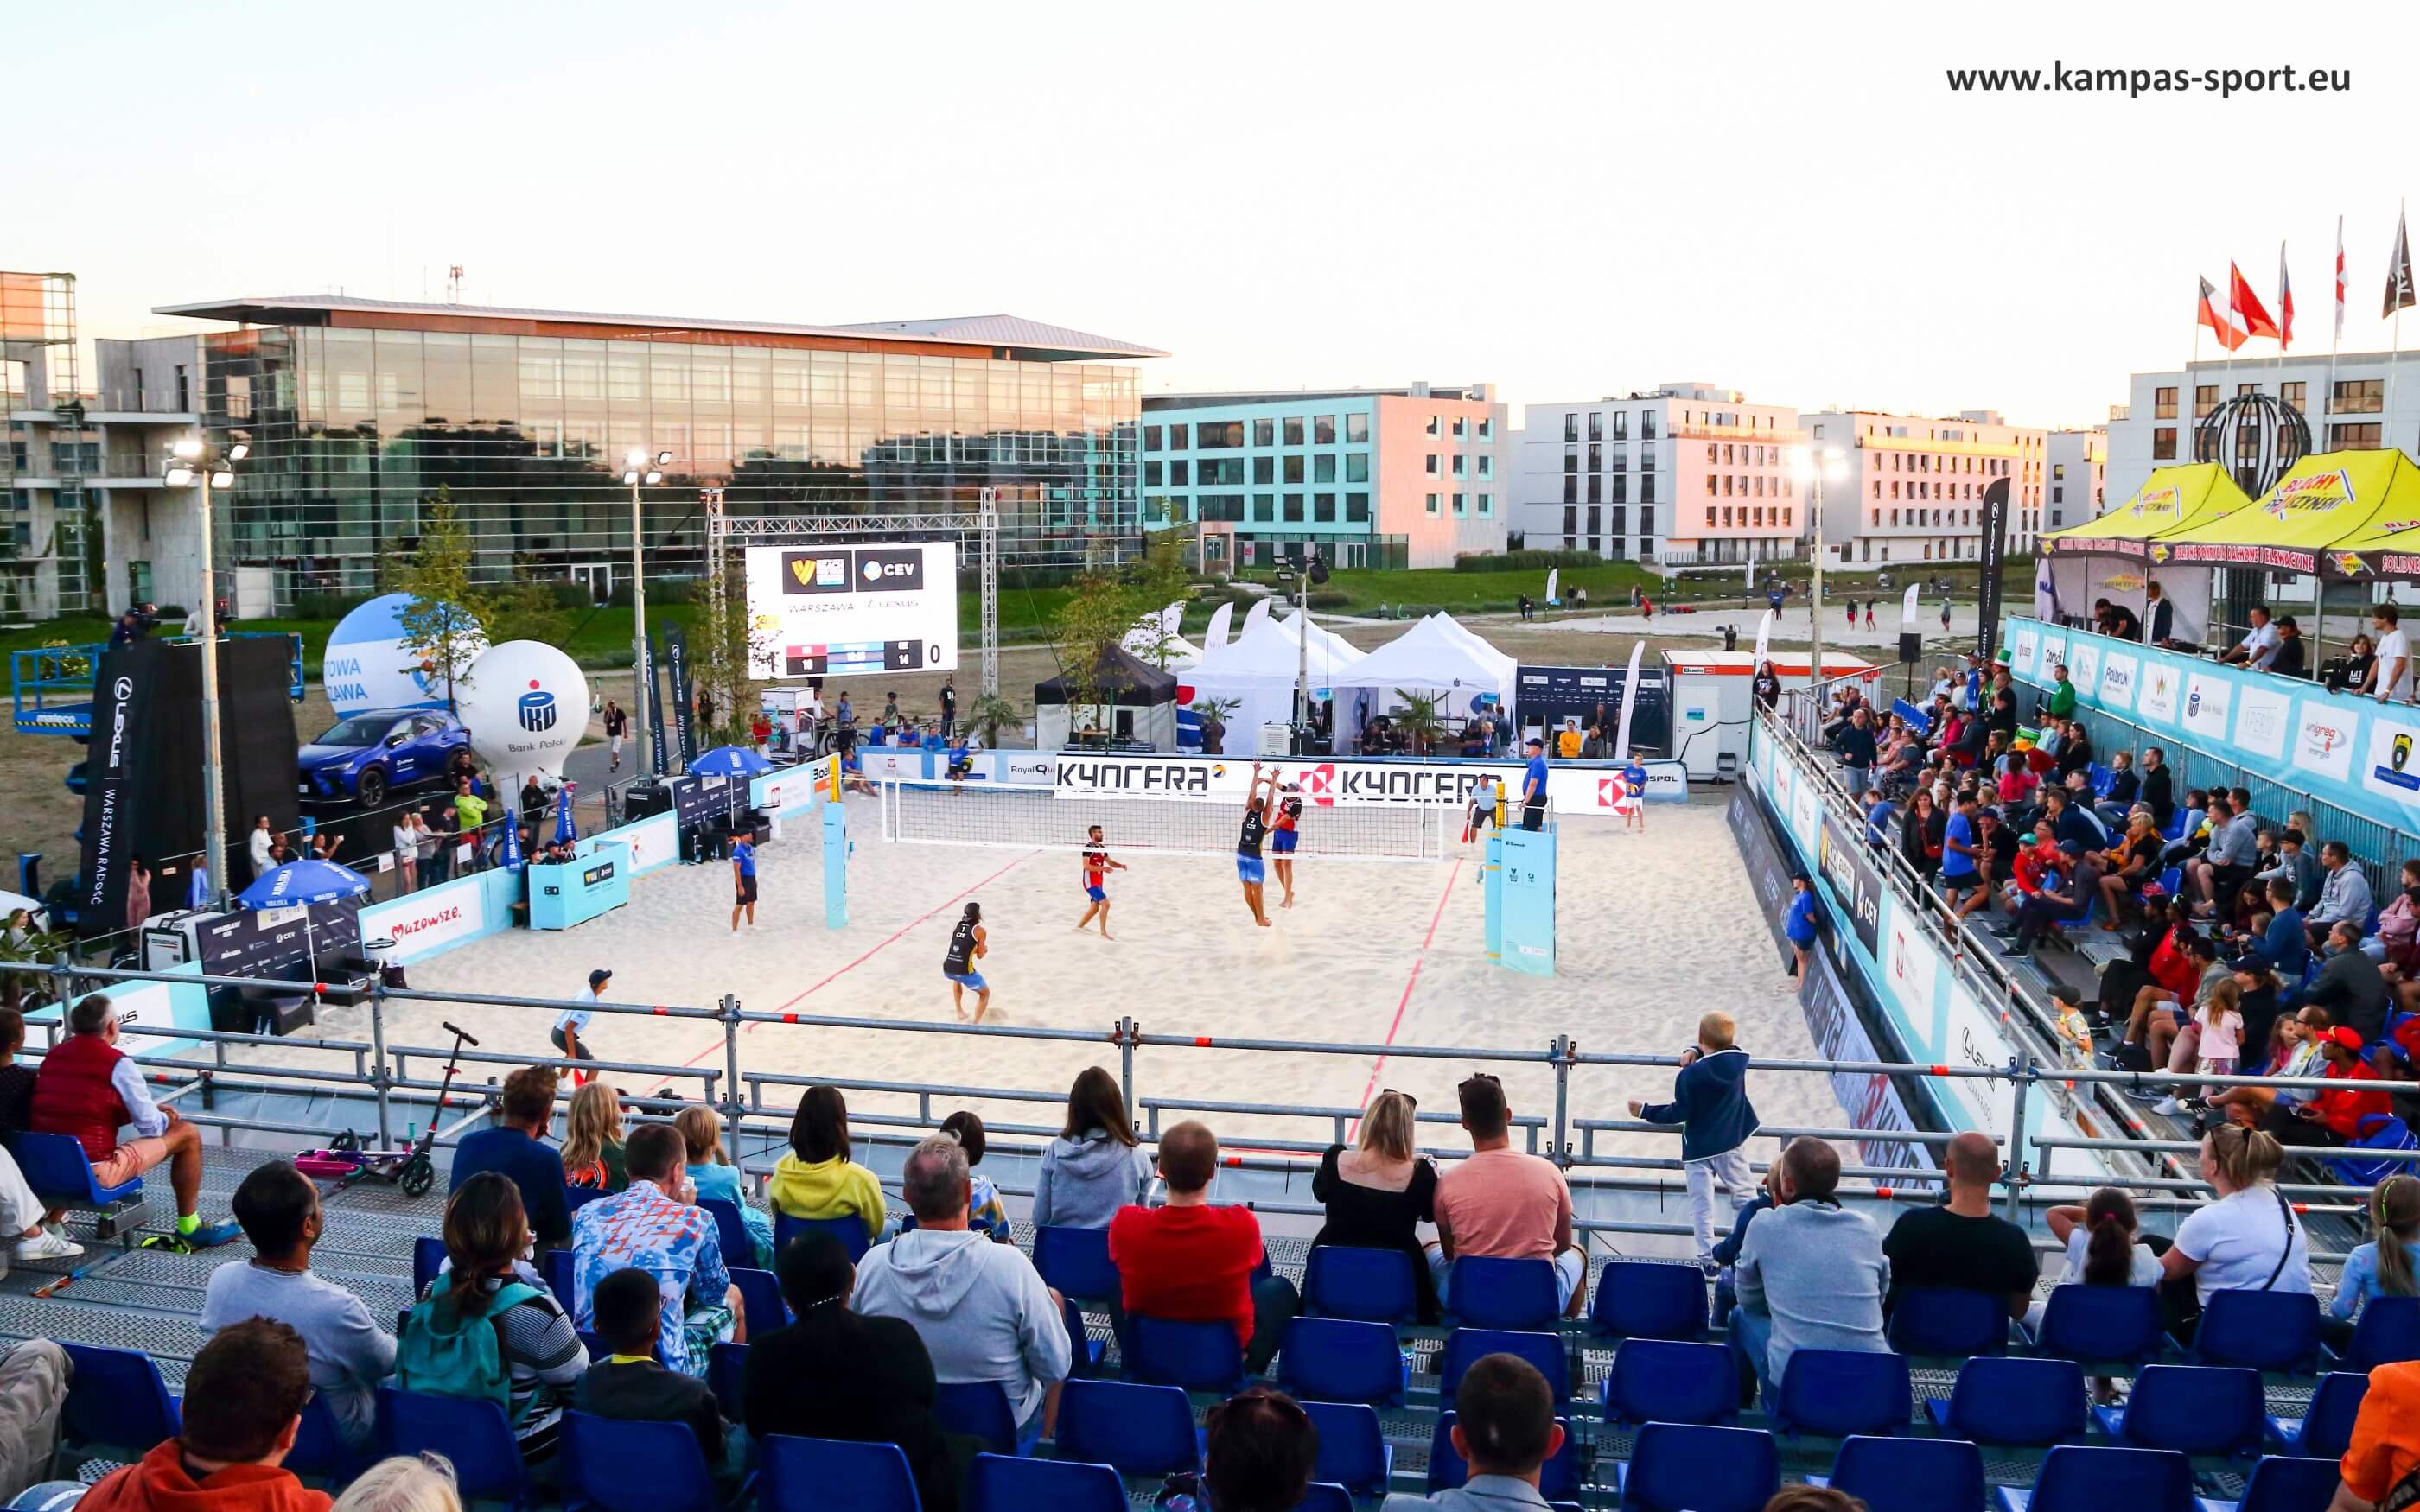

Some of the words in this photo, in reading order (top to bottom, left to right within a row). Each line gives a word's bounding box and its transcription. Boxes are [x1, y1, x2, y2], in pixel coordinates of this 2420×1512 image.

[2227, 545, 2259, 563] DACHOWE
[883, 563, 914, 577] CEV
[789, 600, 855, 614] WARSZAWA
[898, 654, 909, 665] 14
[930, 645, 941, 664] 0
[36, 714, 76, 723] mateco
[109, 702, 127, 768] LEXUS
[508, 741, 536, 753] Bank
[1010, 766, 1035, 779] Royal
[1342, 771, 1502, 804] KYOCER
[98, 789, 117, 855] WARSZAWA
[1864, 896, 1878, 931] CEV
